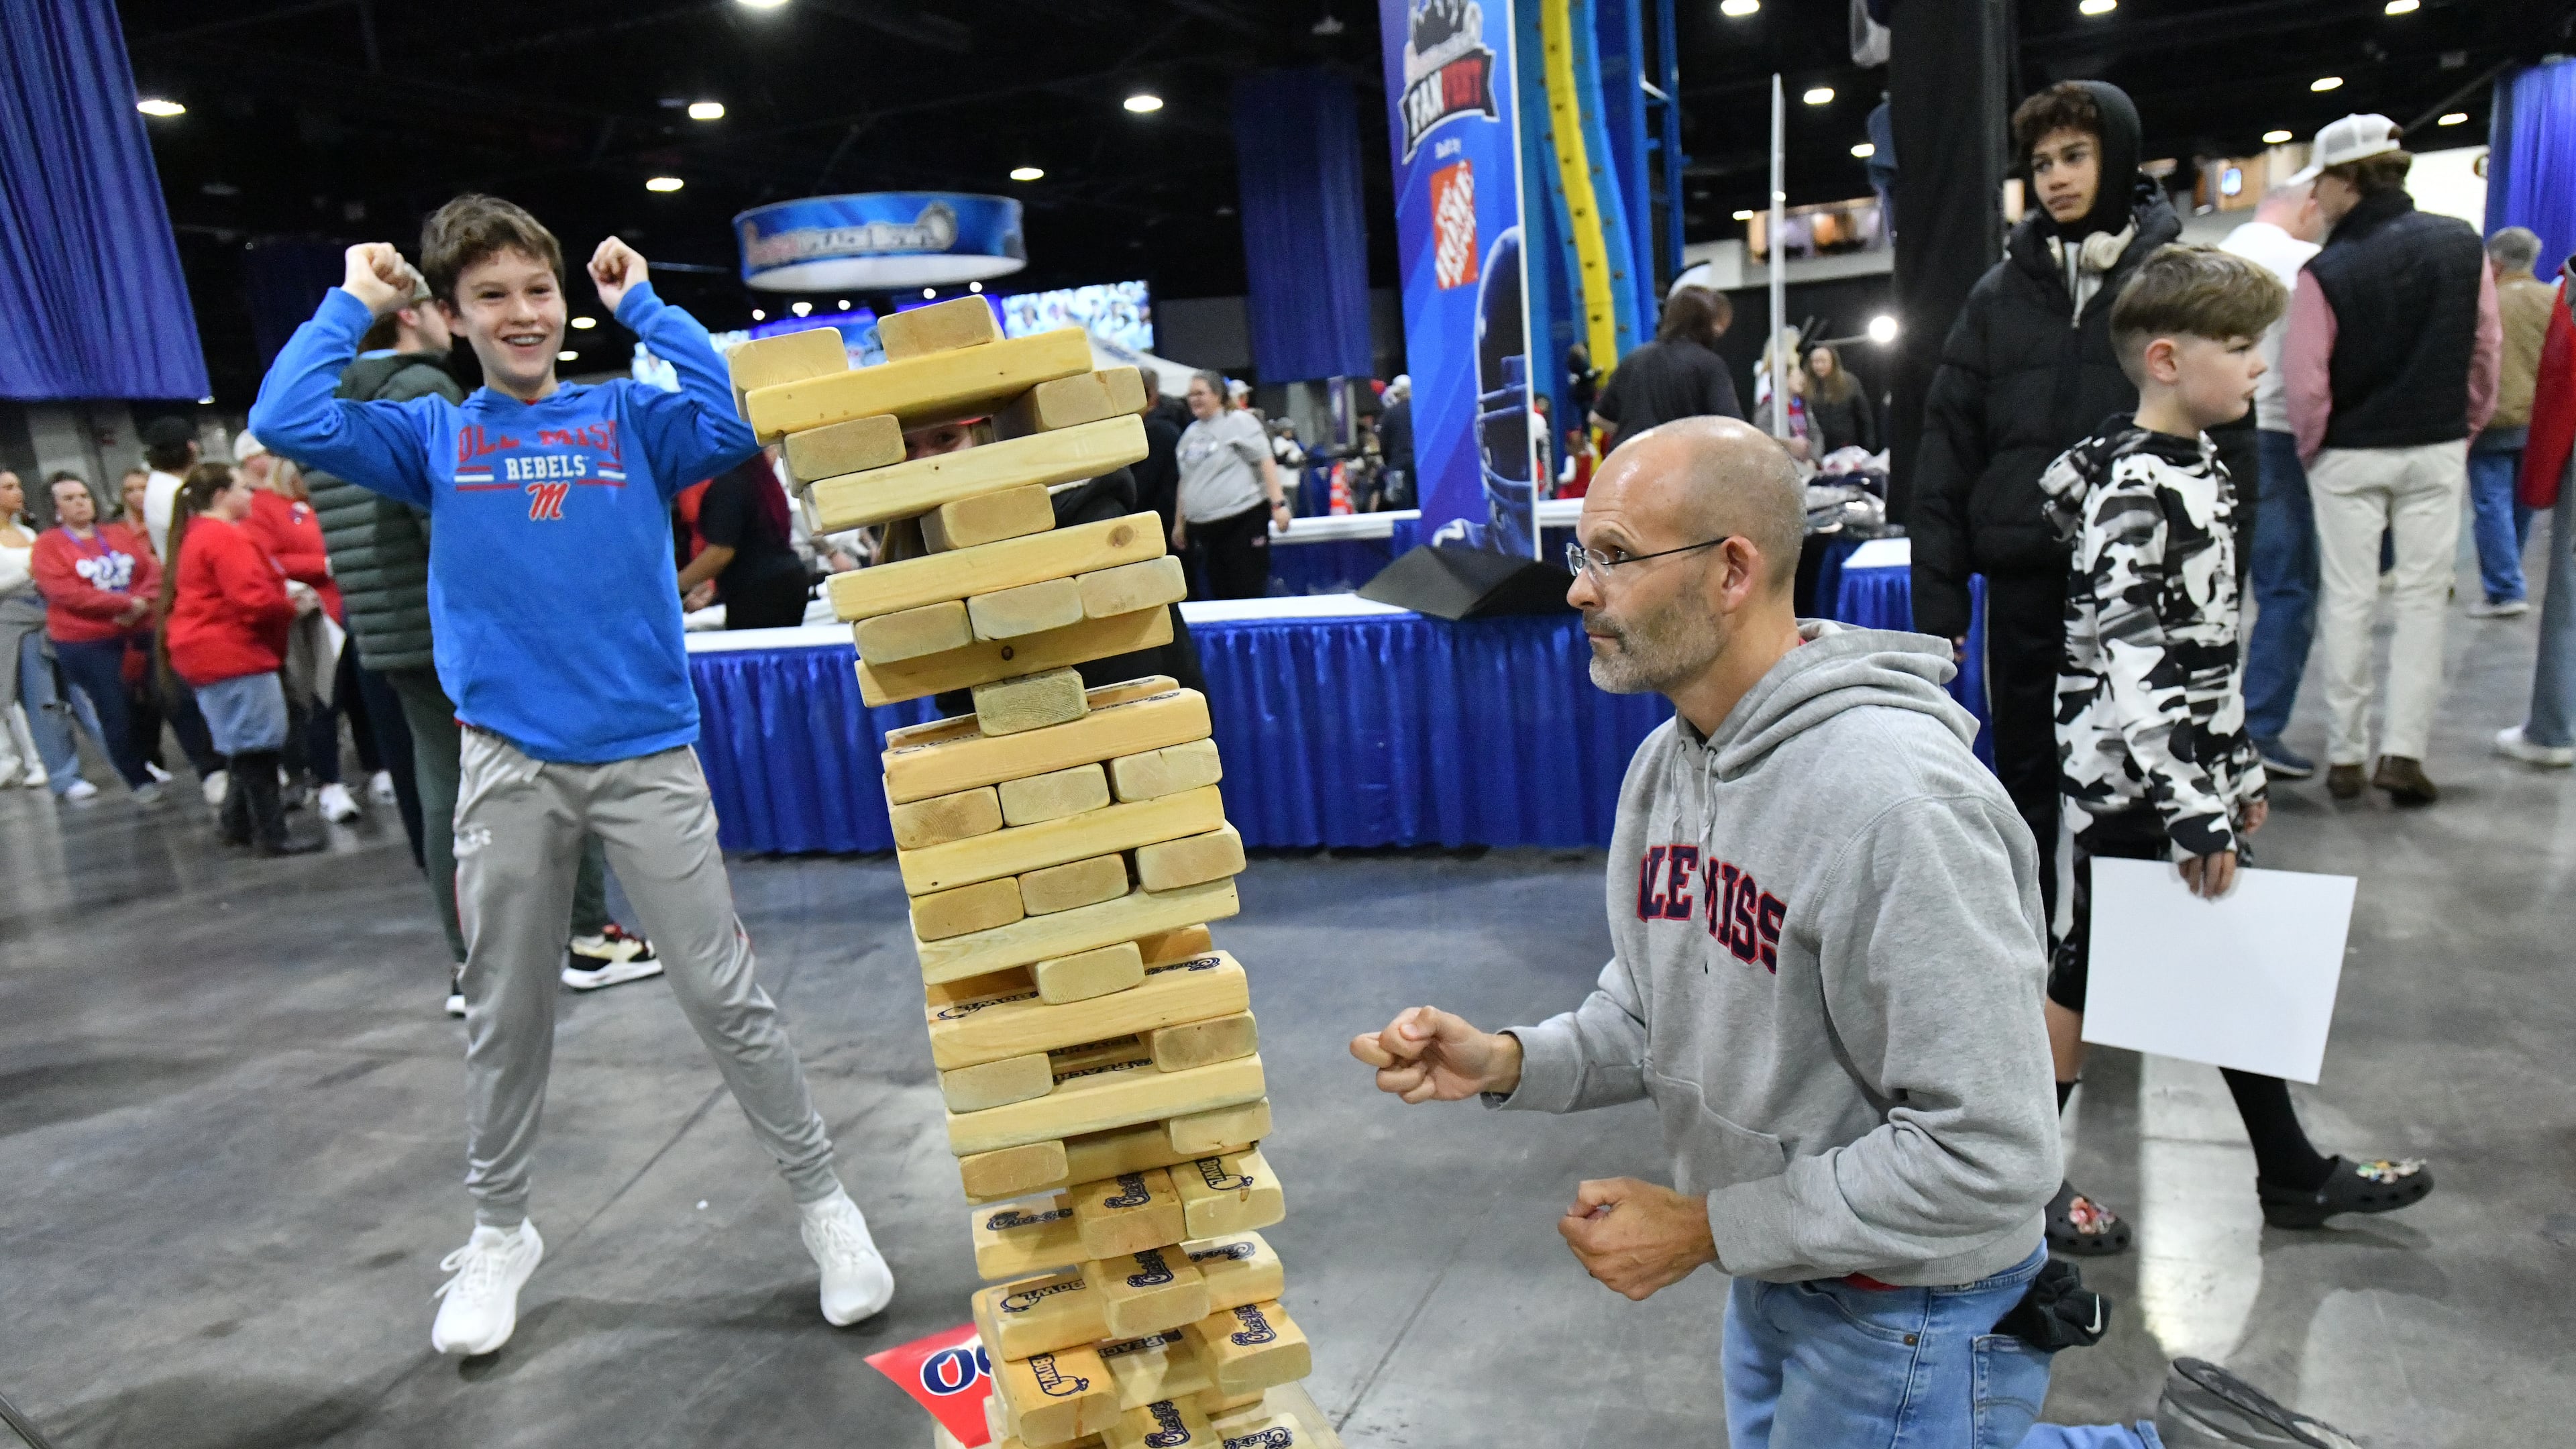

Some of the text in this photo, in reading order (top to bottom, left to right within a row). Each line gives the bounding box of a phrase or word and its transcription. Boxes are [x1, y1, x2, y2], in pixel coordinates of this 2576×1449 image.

[505, 455, 587, 480] REBELS
[1198, 1157, 1227, 1187] BOWL
[1021, 1279, 1086, 1300] BOWL
[1030, 1355, 1061, 1391] BOWL
